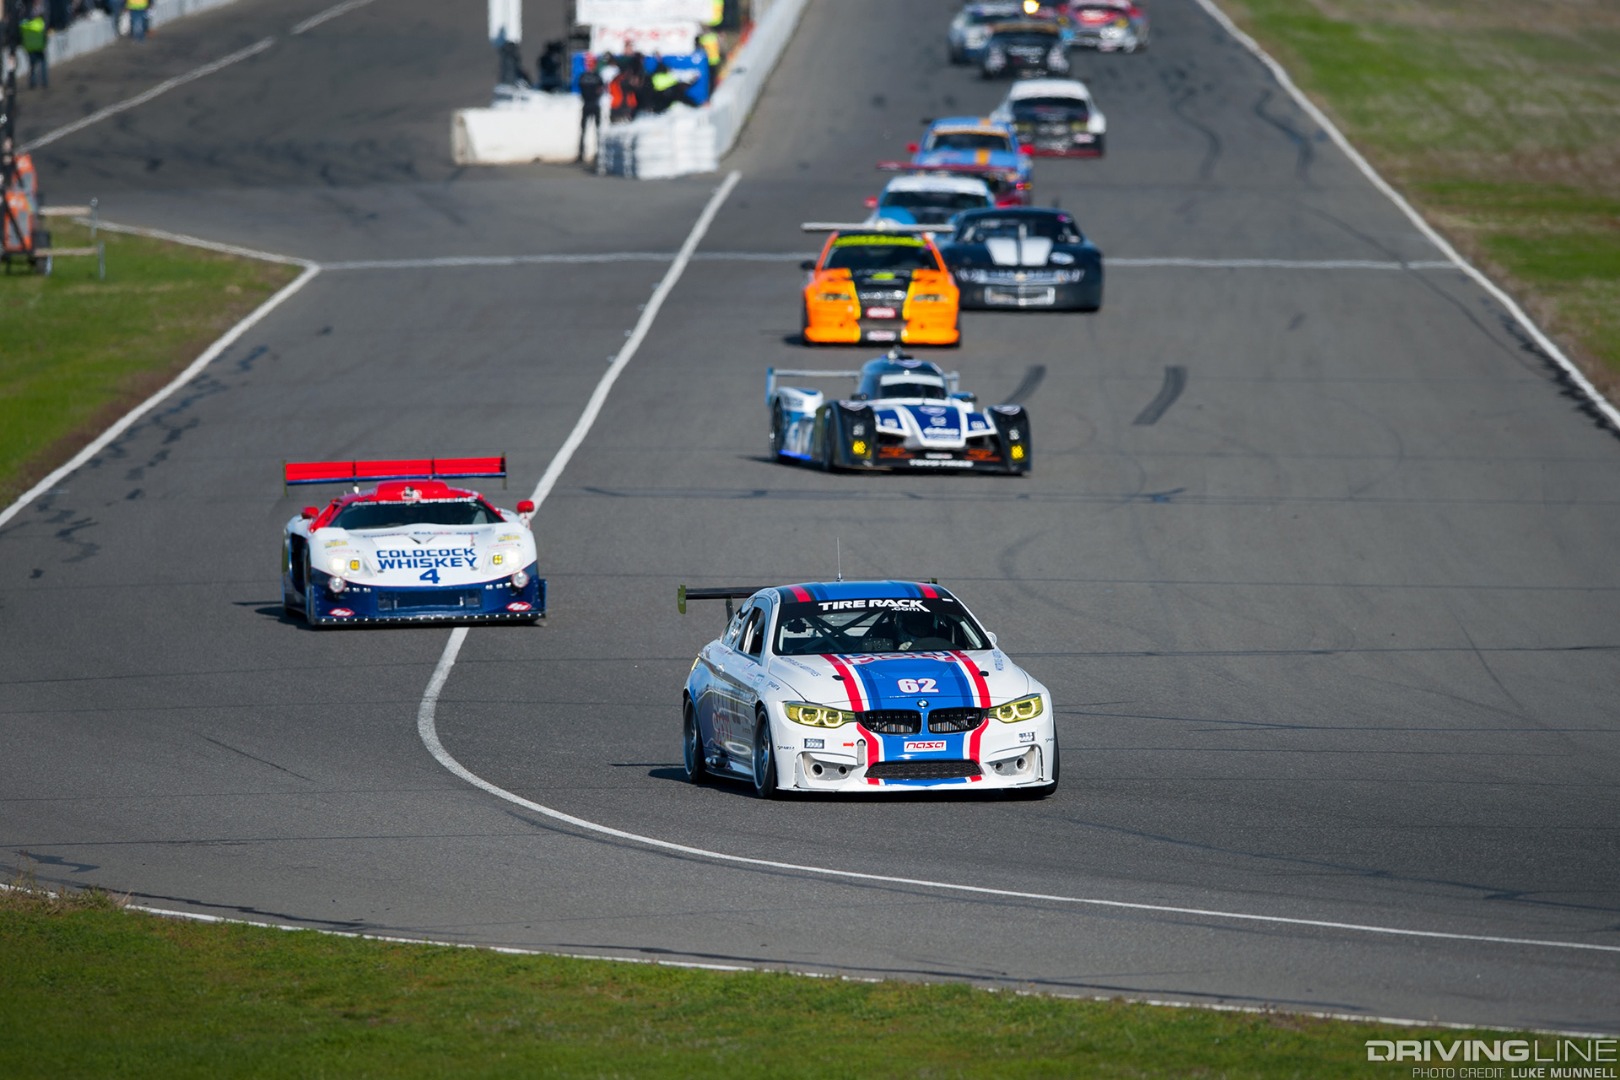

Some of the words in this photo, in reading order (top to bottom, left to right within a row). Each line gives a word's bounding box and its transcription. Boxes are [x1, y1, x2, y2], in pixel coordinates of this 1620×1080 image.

[376, 548, 477, 559] COLDCOCK
[378, 557, 477, 570] WHISKEY
[419, 568, 441, 584] 4
[818, 600, 866, 611] TIRE
[869, 599, 930, 612] RACK
[898, 678, 940, 694] 62
[905, 741, 945, 750] nasa
